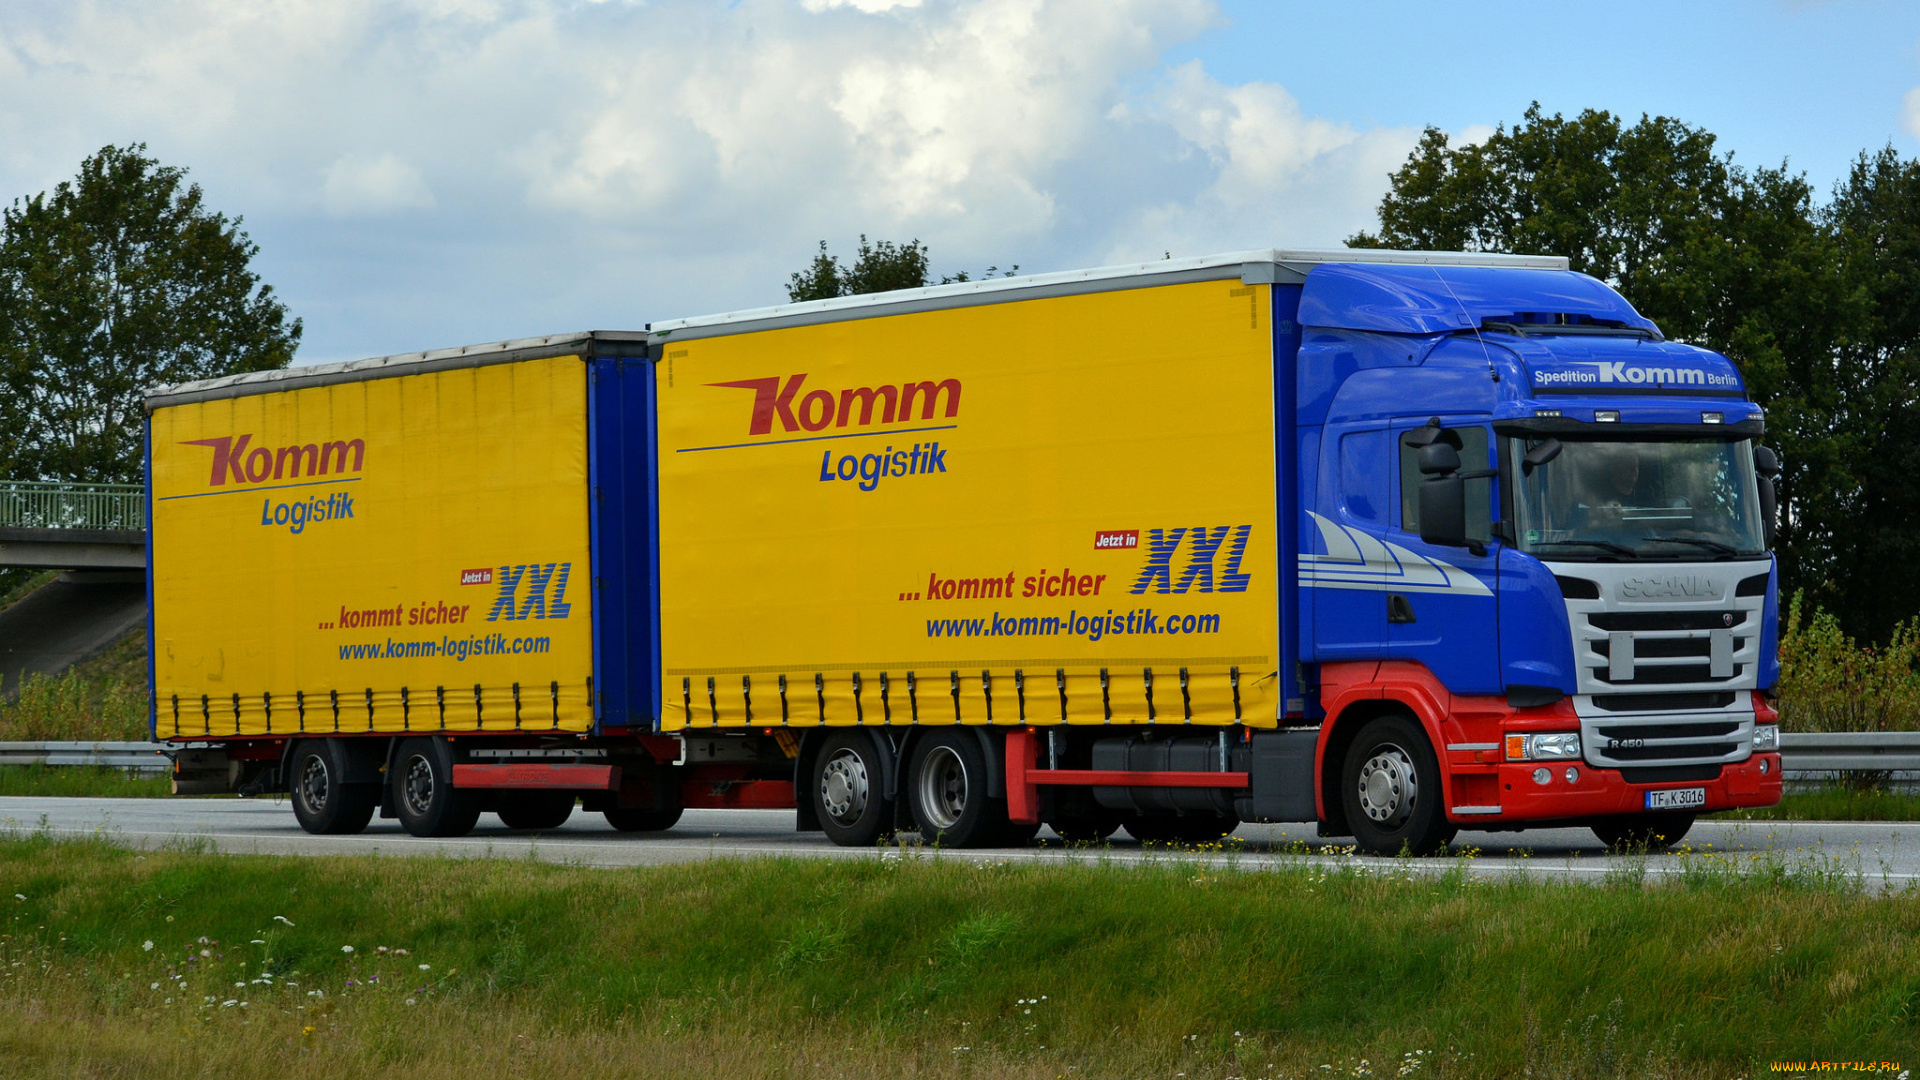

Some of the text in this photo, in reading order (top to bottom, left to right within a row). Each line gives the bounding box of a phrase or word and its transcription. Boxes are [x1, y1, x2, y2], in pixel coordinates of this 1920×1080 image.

[1534, 361, 1738, 386] Spedition Komm Berlin
[699, 373, 962, 436] Komm
[175, 433, 366, 487] Komm
[819, 442, 947, 492] Logistik
[260, 492, 355, 534] Logistik
[1096, 533, 1137, 547] Jetzt in
[1125, 524, 1253, 595] XXL
[462, 571, 491, 584] Jetzt in
[483, 562, 572, 622] XXL
[927, 570, 1015, 600] kommt
[1022, 568, 1106, 598] sicher
[1622, 575, 1718, 598] SCANIA
[338, 603, 403, 629] kommt
[408, 601, 470, 626] sicher
[926, 608, 1220, 641] www.komm-logistik.com
[338, 633, 550, 661] www.komm-logistik.com
[1611, 738, 1643, 749] R 450
[1679, 790, 1704, 804] 3016
